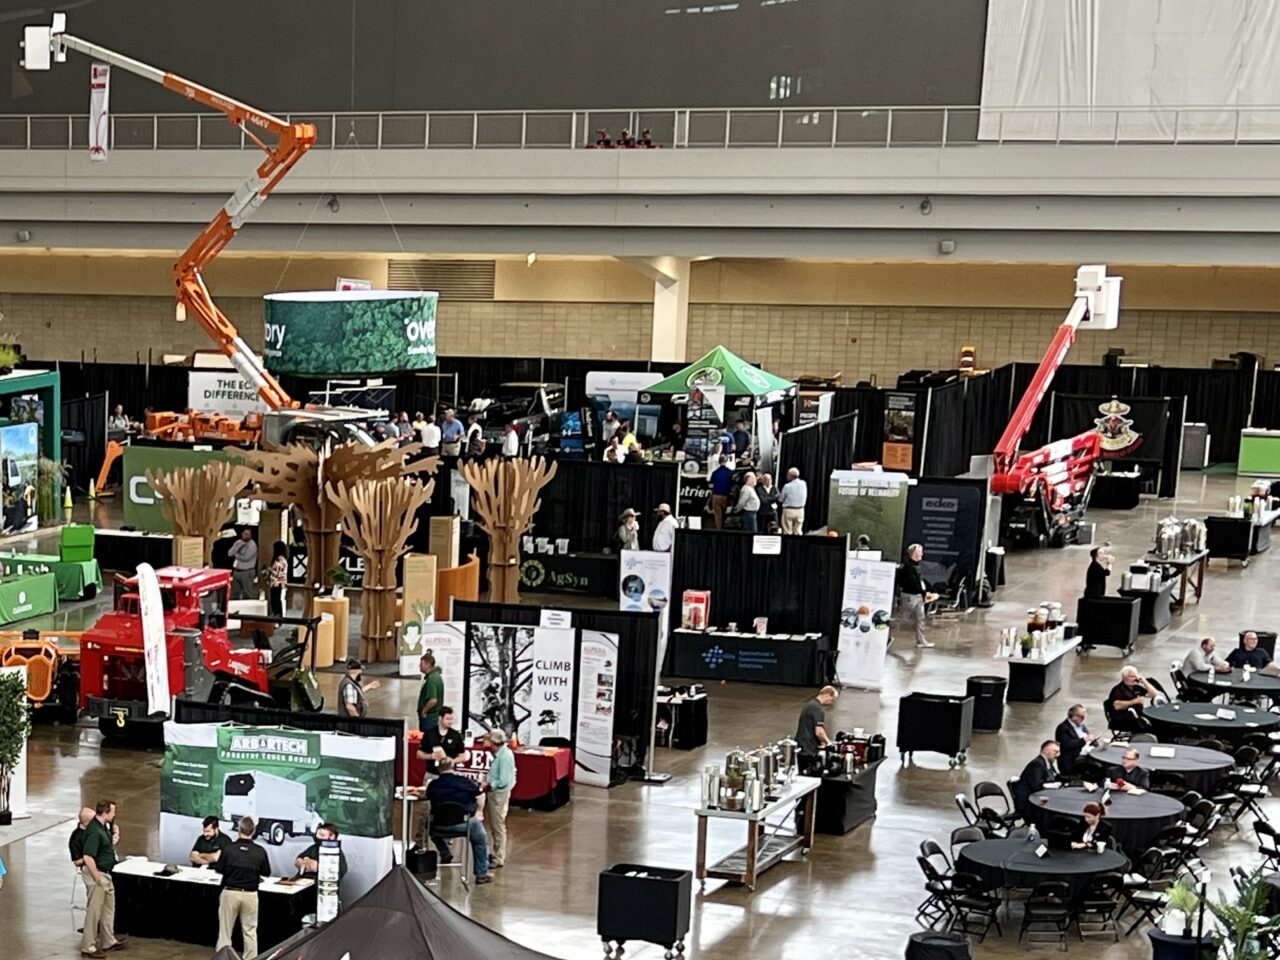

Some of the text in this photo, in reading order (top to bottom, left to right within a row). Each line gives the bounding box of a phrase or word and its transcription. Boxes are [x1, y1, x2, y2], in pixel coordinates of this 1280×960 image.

[217, 379, 236, 390] THE
[204, 390, 260, 402] DIFFERENCE
[547, 570, 589, 586] AgSyn
[535, 660, 571, 672] CLIMB
[537, 676, 568, 687] WITH
[221, 751, 317, 765] FORESTRY TRUCK BODIES
